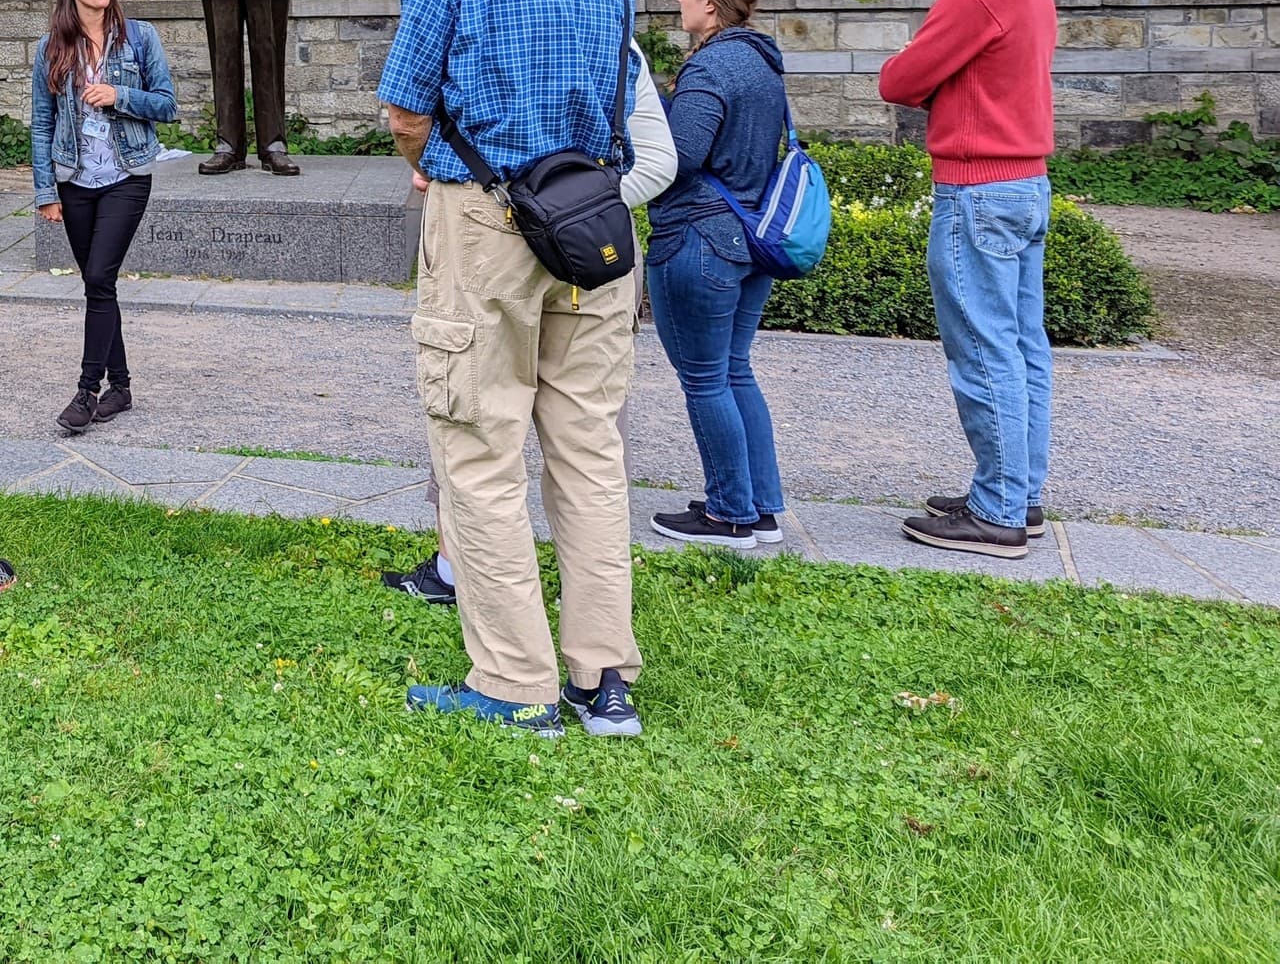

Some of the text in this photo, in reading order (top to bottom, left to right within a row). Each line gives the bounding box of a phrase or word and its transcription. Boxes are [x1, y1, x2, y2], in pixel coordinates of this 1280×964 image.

[147, 225, 283, 247] Jean Drapeau
[512, 704, 548, 723] HOKA
